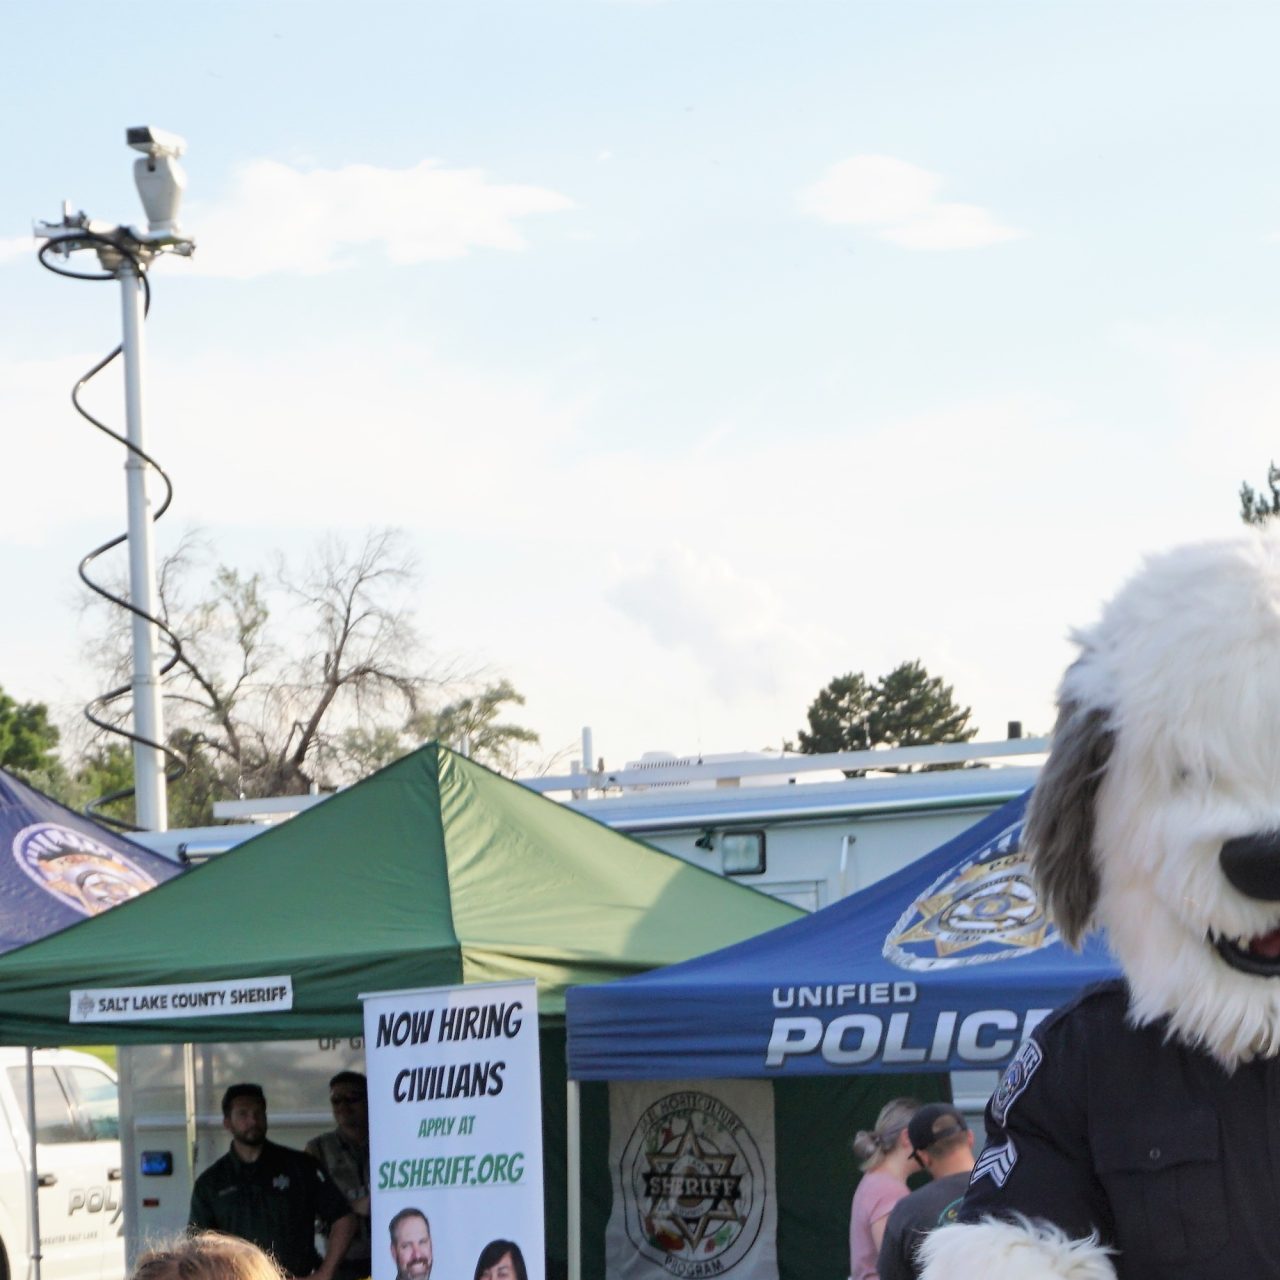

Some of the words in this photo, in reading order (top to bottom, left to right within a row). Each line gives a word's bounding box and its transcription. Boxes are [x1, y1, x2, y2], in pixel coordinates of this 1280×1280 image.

[98, 998, 128, 1012] SALT
[133, 995, 167, 1010] LAKE
[172, 991, 226, 1009] COUNTY
[230, 986, 287, 1004] SHERIFF
[772, 981, 918, 1009] UNIFIED
[376, 1009, 435, 1048] NOW
[438, 1002, 523, 1043] HIRING
[393, 1061, 506, 1104] CIVILIANS
[418, 1116, 458, 1138] APPLY
[457, 1115, 476, 1135] AT
[378, 1151, 525, 1190] SLSHERIFF.ORG
[650, 1176, 736, 1197] SHERIFF
[665, 1254, 725, 1279] PROGRAM
